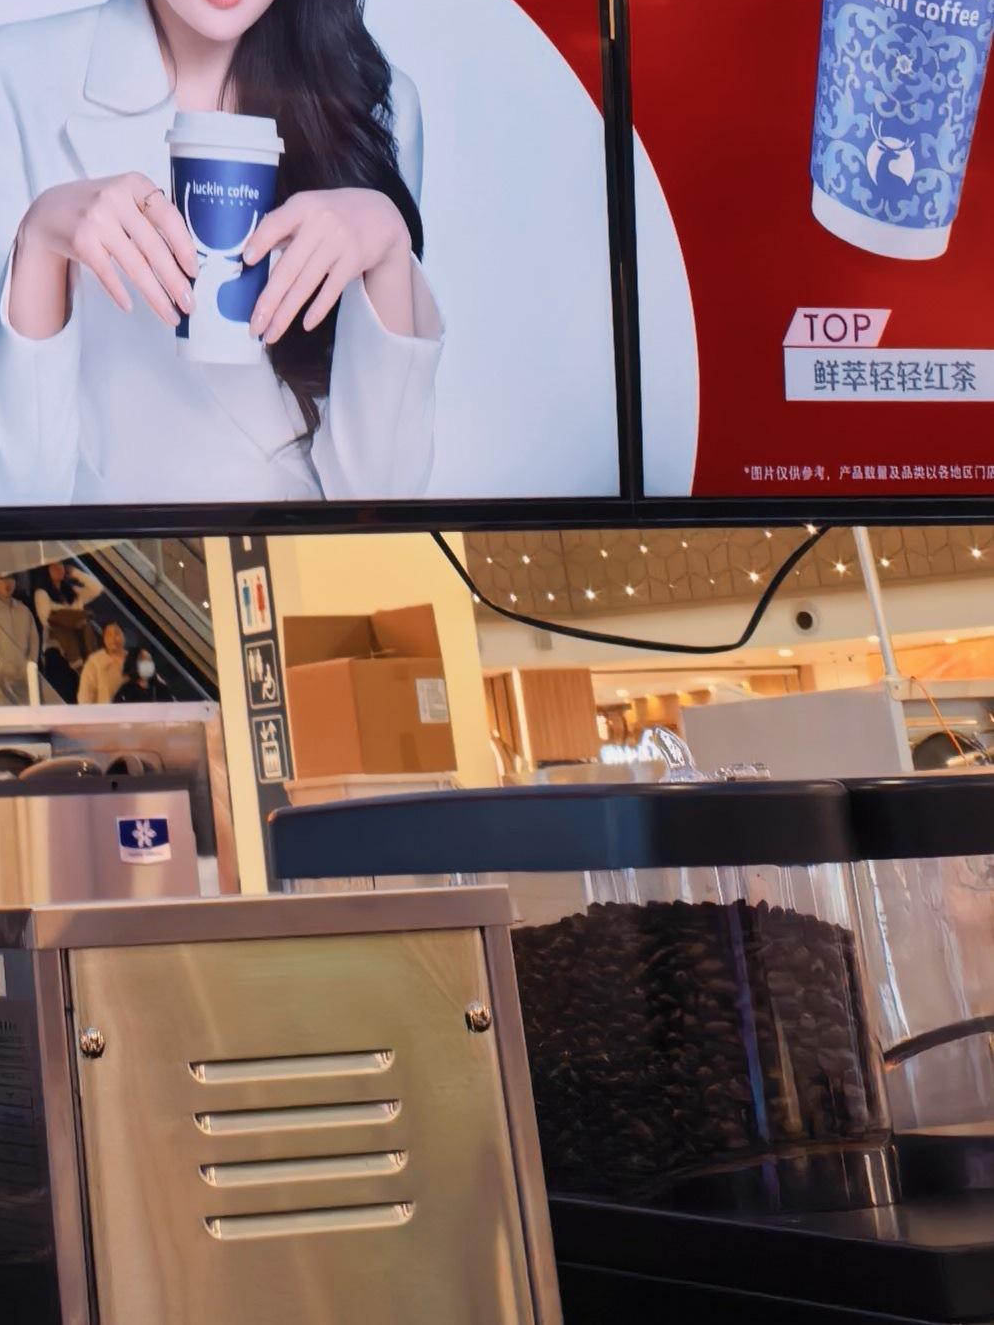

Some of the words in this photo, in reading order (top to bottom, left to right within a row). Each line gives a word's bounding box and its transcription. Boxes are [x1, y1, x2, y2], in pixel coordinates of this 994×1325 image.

[914, 0, 980, 28] coffee
[192, 179, 224, 197] luckin
[227, 184, 260, 200] coffee
[803, 312, 872, 343] TOP
[813, 359, 977, 393] 鲜萃轻轻红茶
